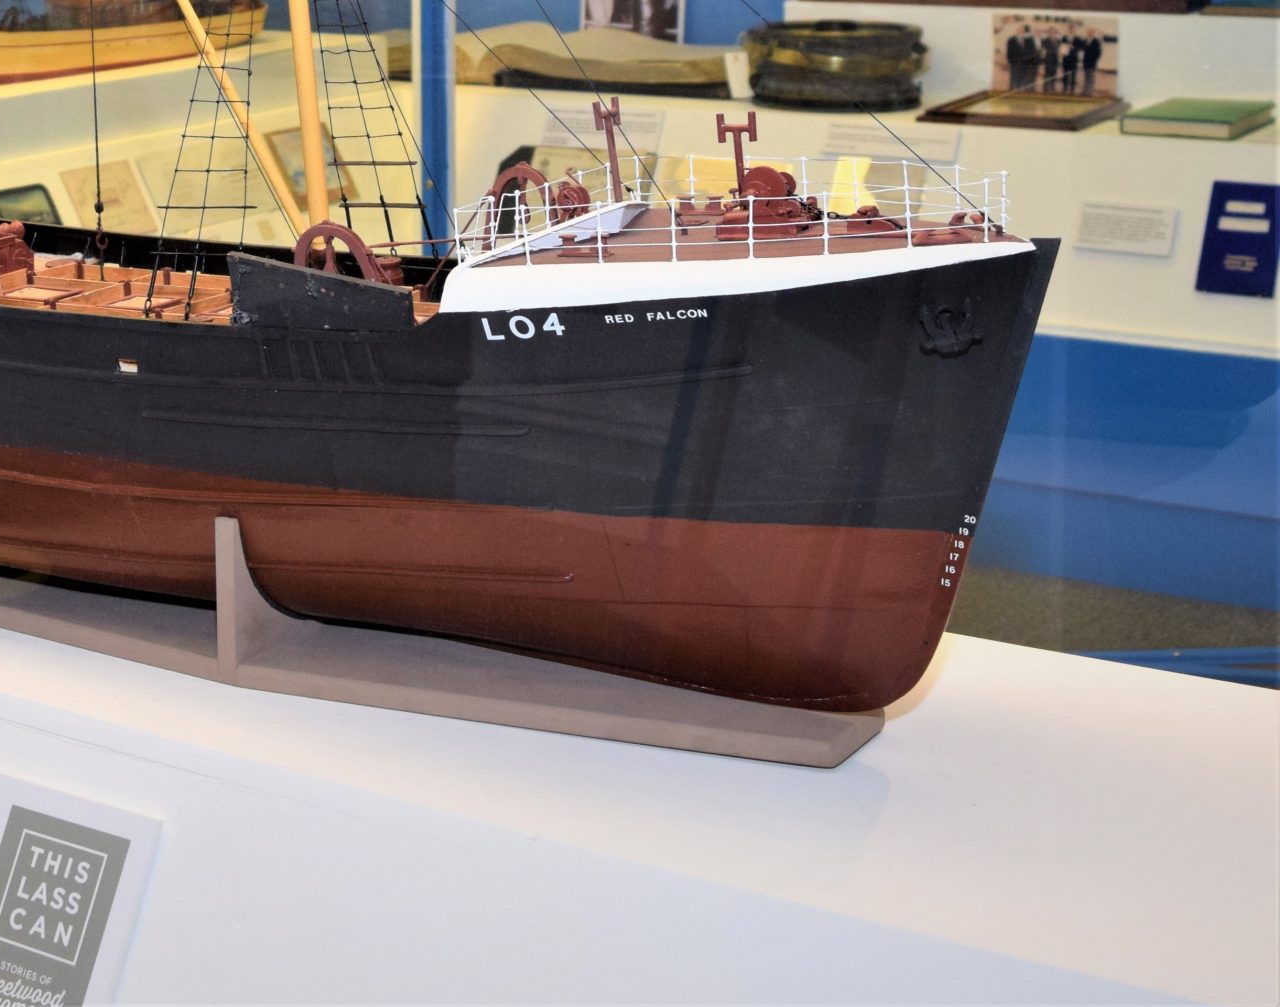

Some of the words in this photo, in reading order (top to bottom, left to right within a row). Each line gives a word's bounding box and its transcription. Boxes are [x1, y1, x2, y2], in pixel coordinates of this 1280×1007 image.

[604, 314, 634, 324] RED
[646, 309, 708, 322] FALCON
[964, 515, 976, 523] 20
[959, 527, 969, 535] 19
[954, 540, 964, 548] 18
[950, 553, 959, 561] 17
[945, 565, 955, 573] 16
[941, 578, 951, 587] 15
[30, 845, 91, 884] THIS
[17, 875, 82, 915] LASS
[9, 907, 73, 947] CAN
[0, 961, 38, 981] STORIES
[40, 975, 52, 985] OF
